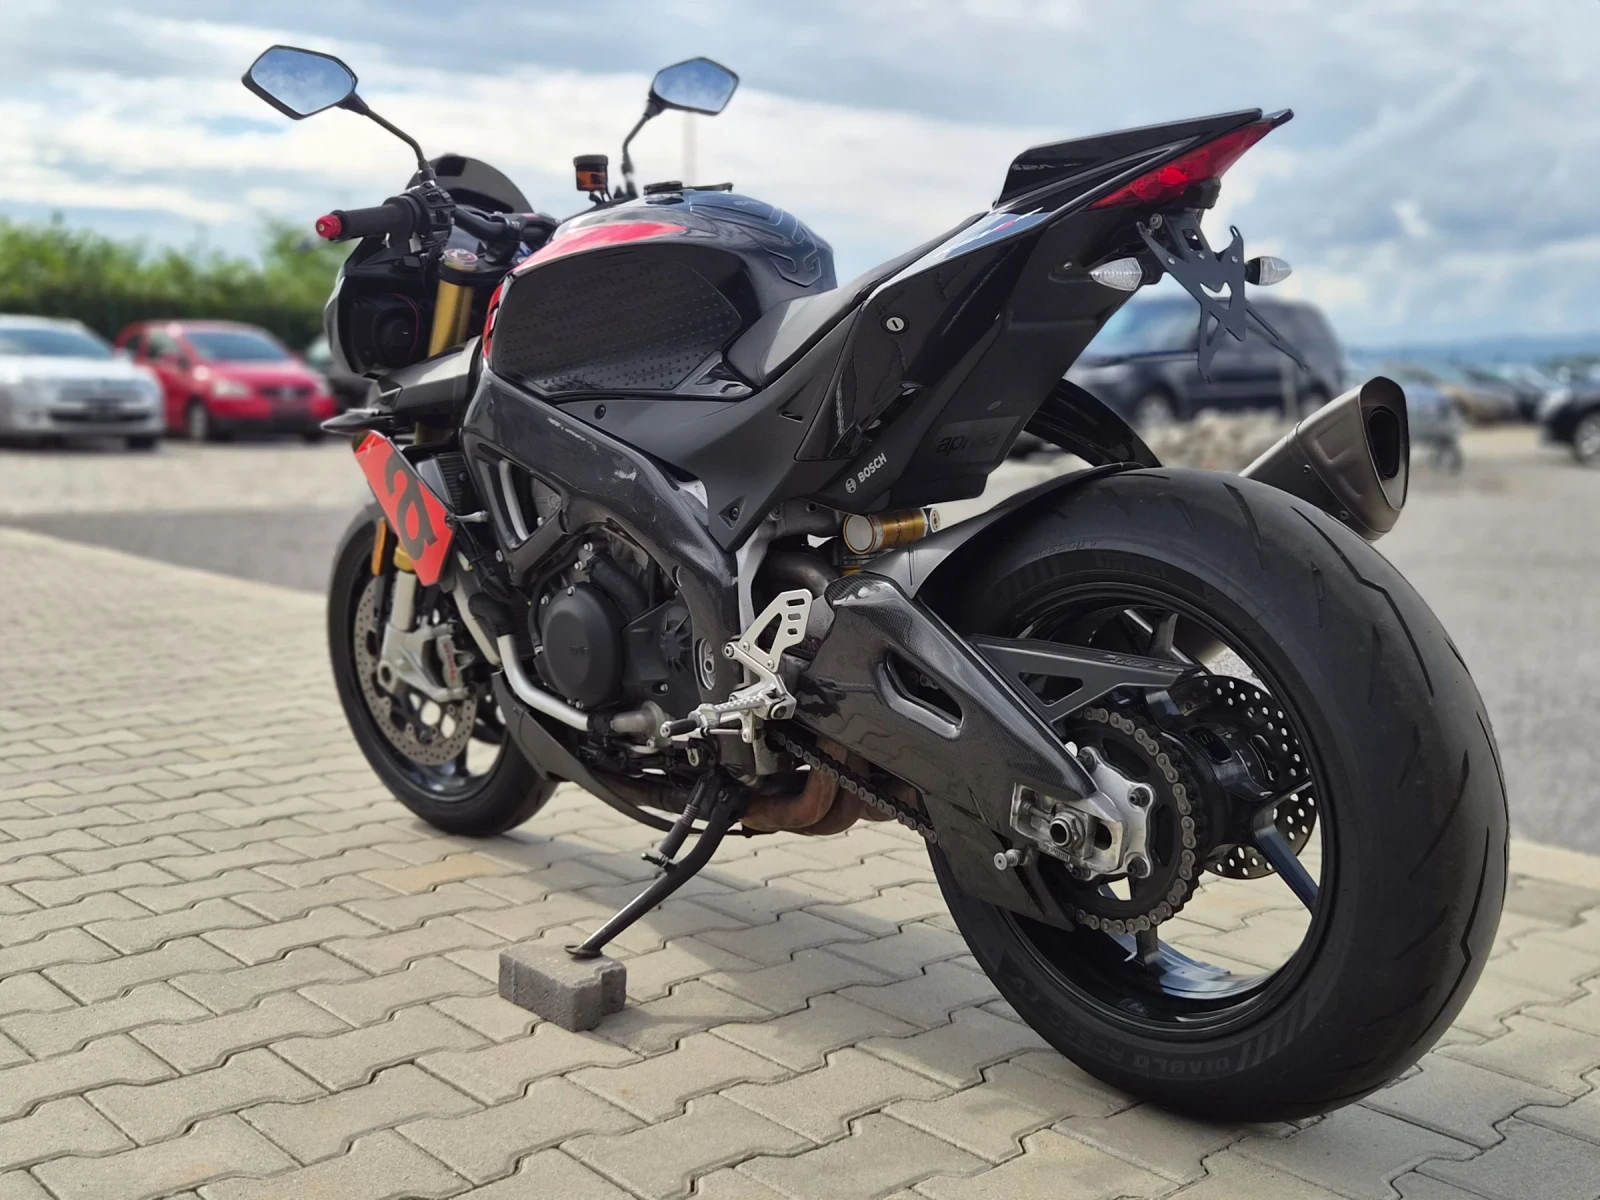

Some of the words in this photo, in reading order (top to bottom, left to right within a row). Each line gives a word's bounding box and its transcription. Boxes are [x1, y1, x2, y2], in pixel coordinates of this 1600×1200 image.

[857, 452, 888, 484] BOSCH
[1048, 1010, 1125, 1063] ROSSO
[1132, 1053, 1231, 1074] DIABLO
